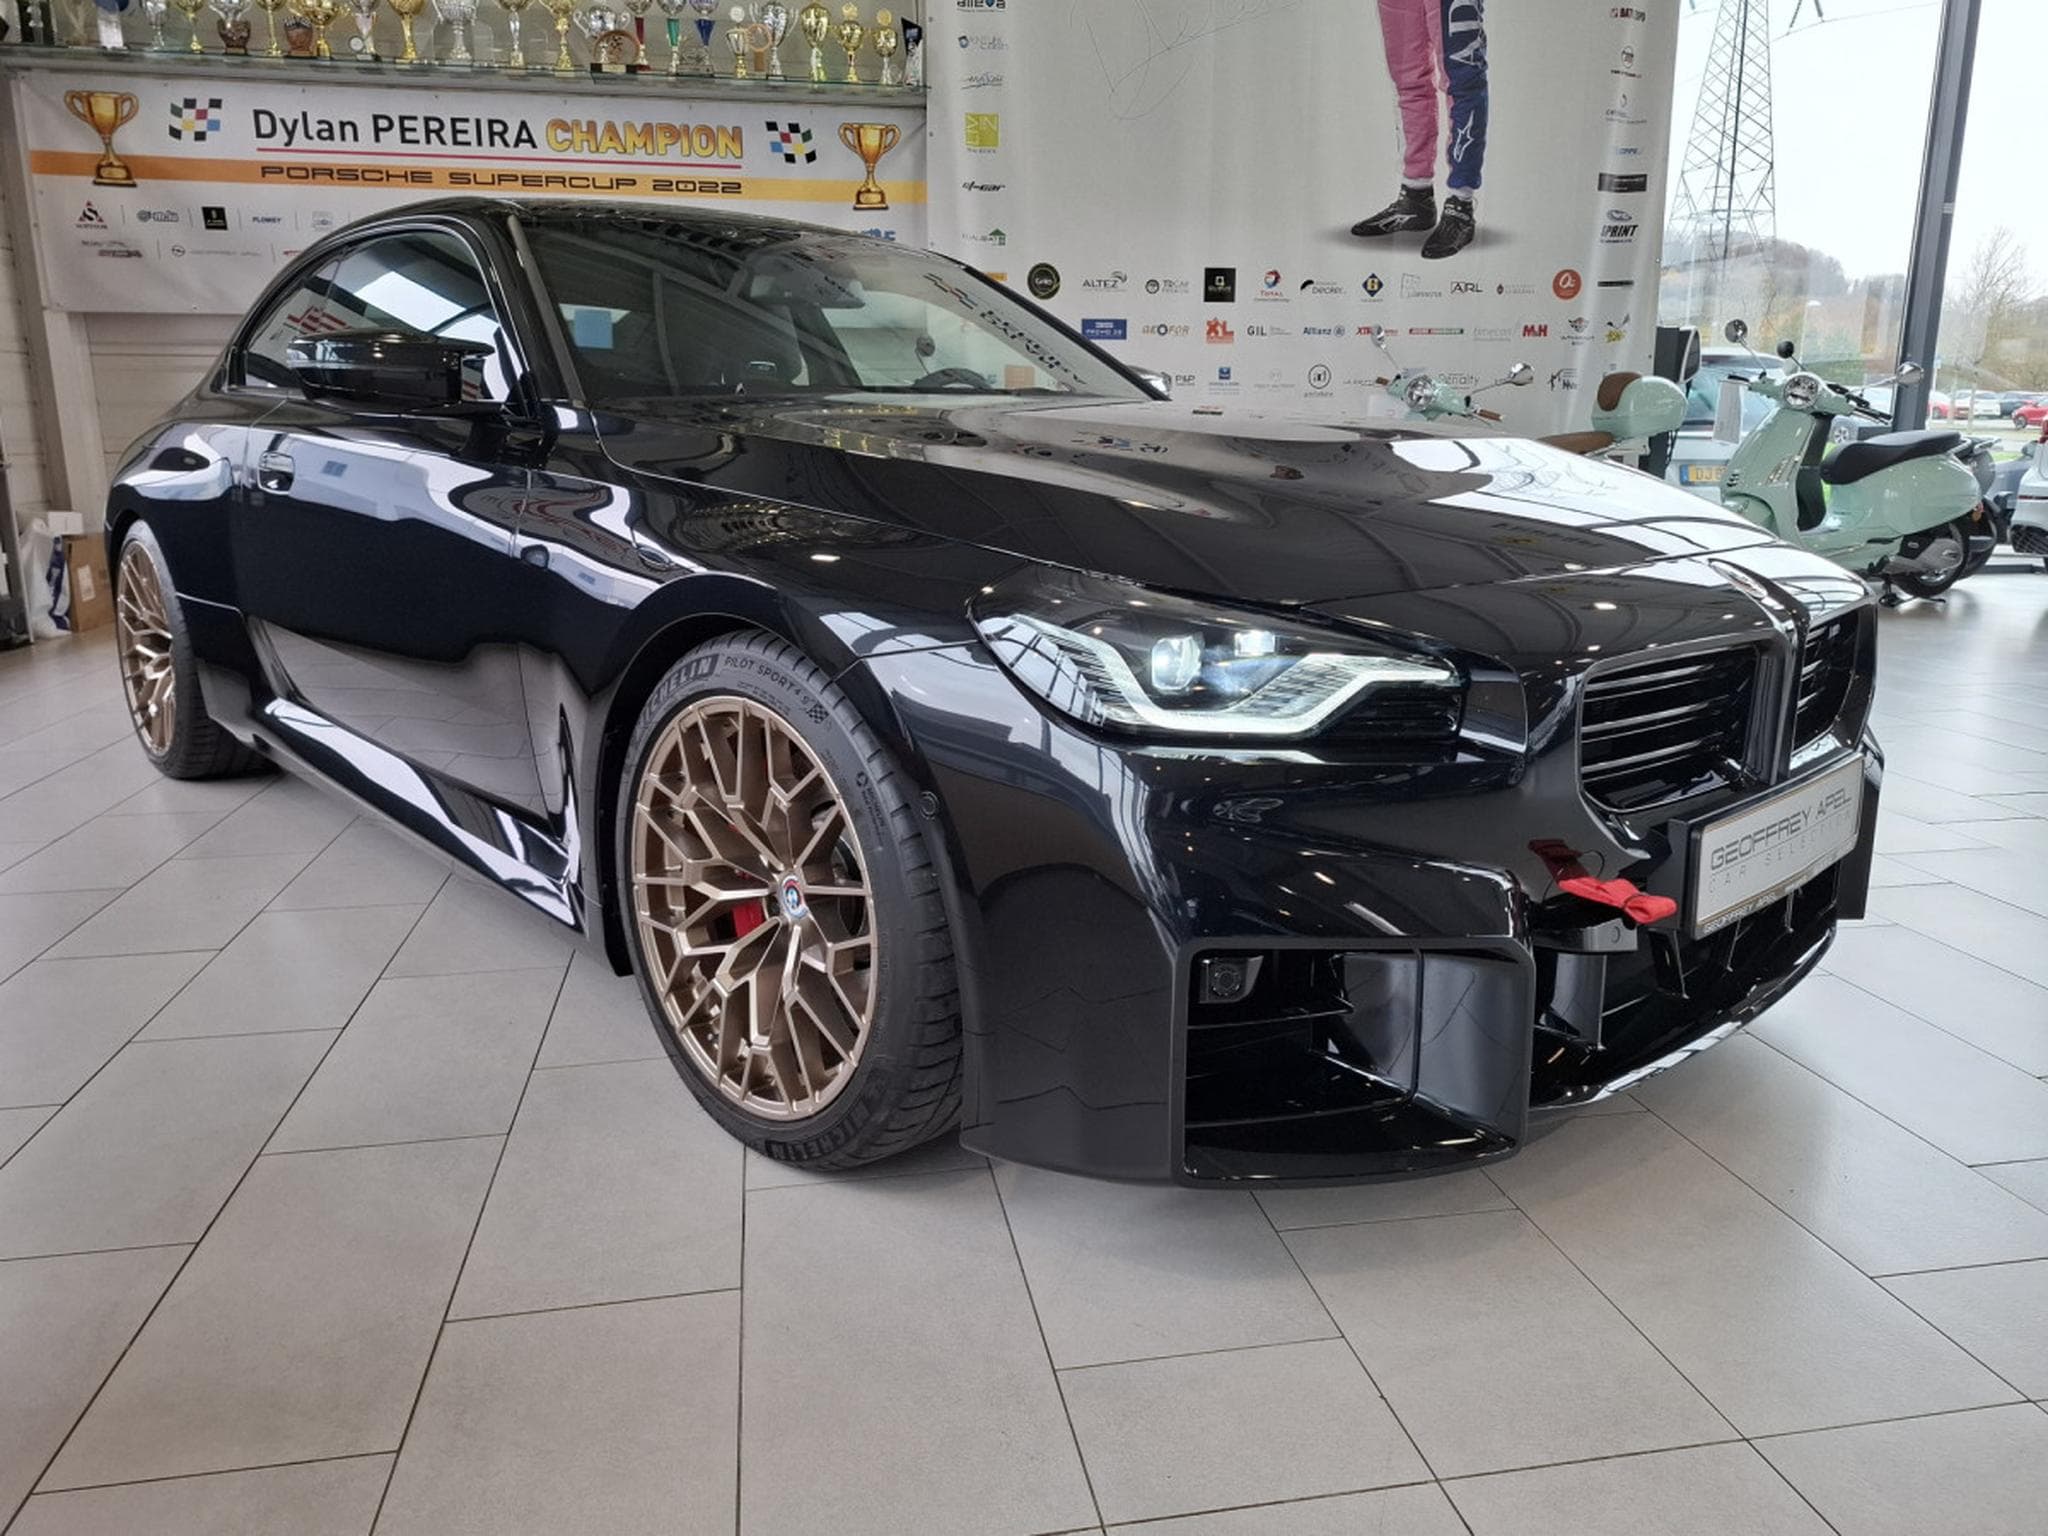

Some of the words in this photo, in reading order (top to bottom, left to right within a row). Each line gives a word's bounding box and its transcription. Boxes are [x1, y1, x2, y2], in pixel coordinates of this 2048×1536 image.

[253, 109, 359, 148] Dylan
[371, 113, 538, 151] PEREIRA
[545, 118, 744, 159] CHAMPION
[261, 166, 433, 184] PORSCHE
[449, 172, 638, 191] SUPERCUP
[652, 179, 742, 194] 2022
[1247, 325, 1266, 336] GIL
[1303, 326, 1332, 335] Allianz
[725, 656, 755, 670] PILOT
[757, 664, 795, 692] SPORT
[1711, 807, 1811, 870] GEOFFREY
